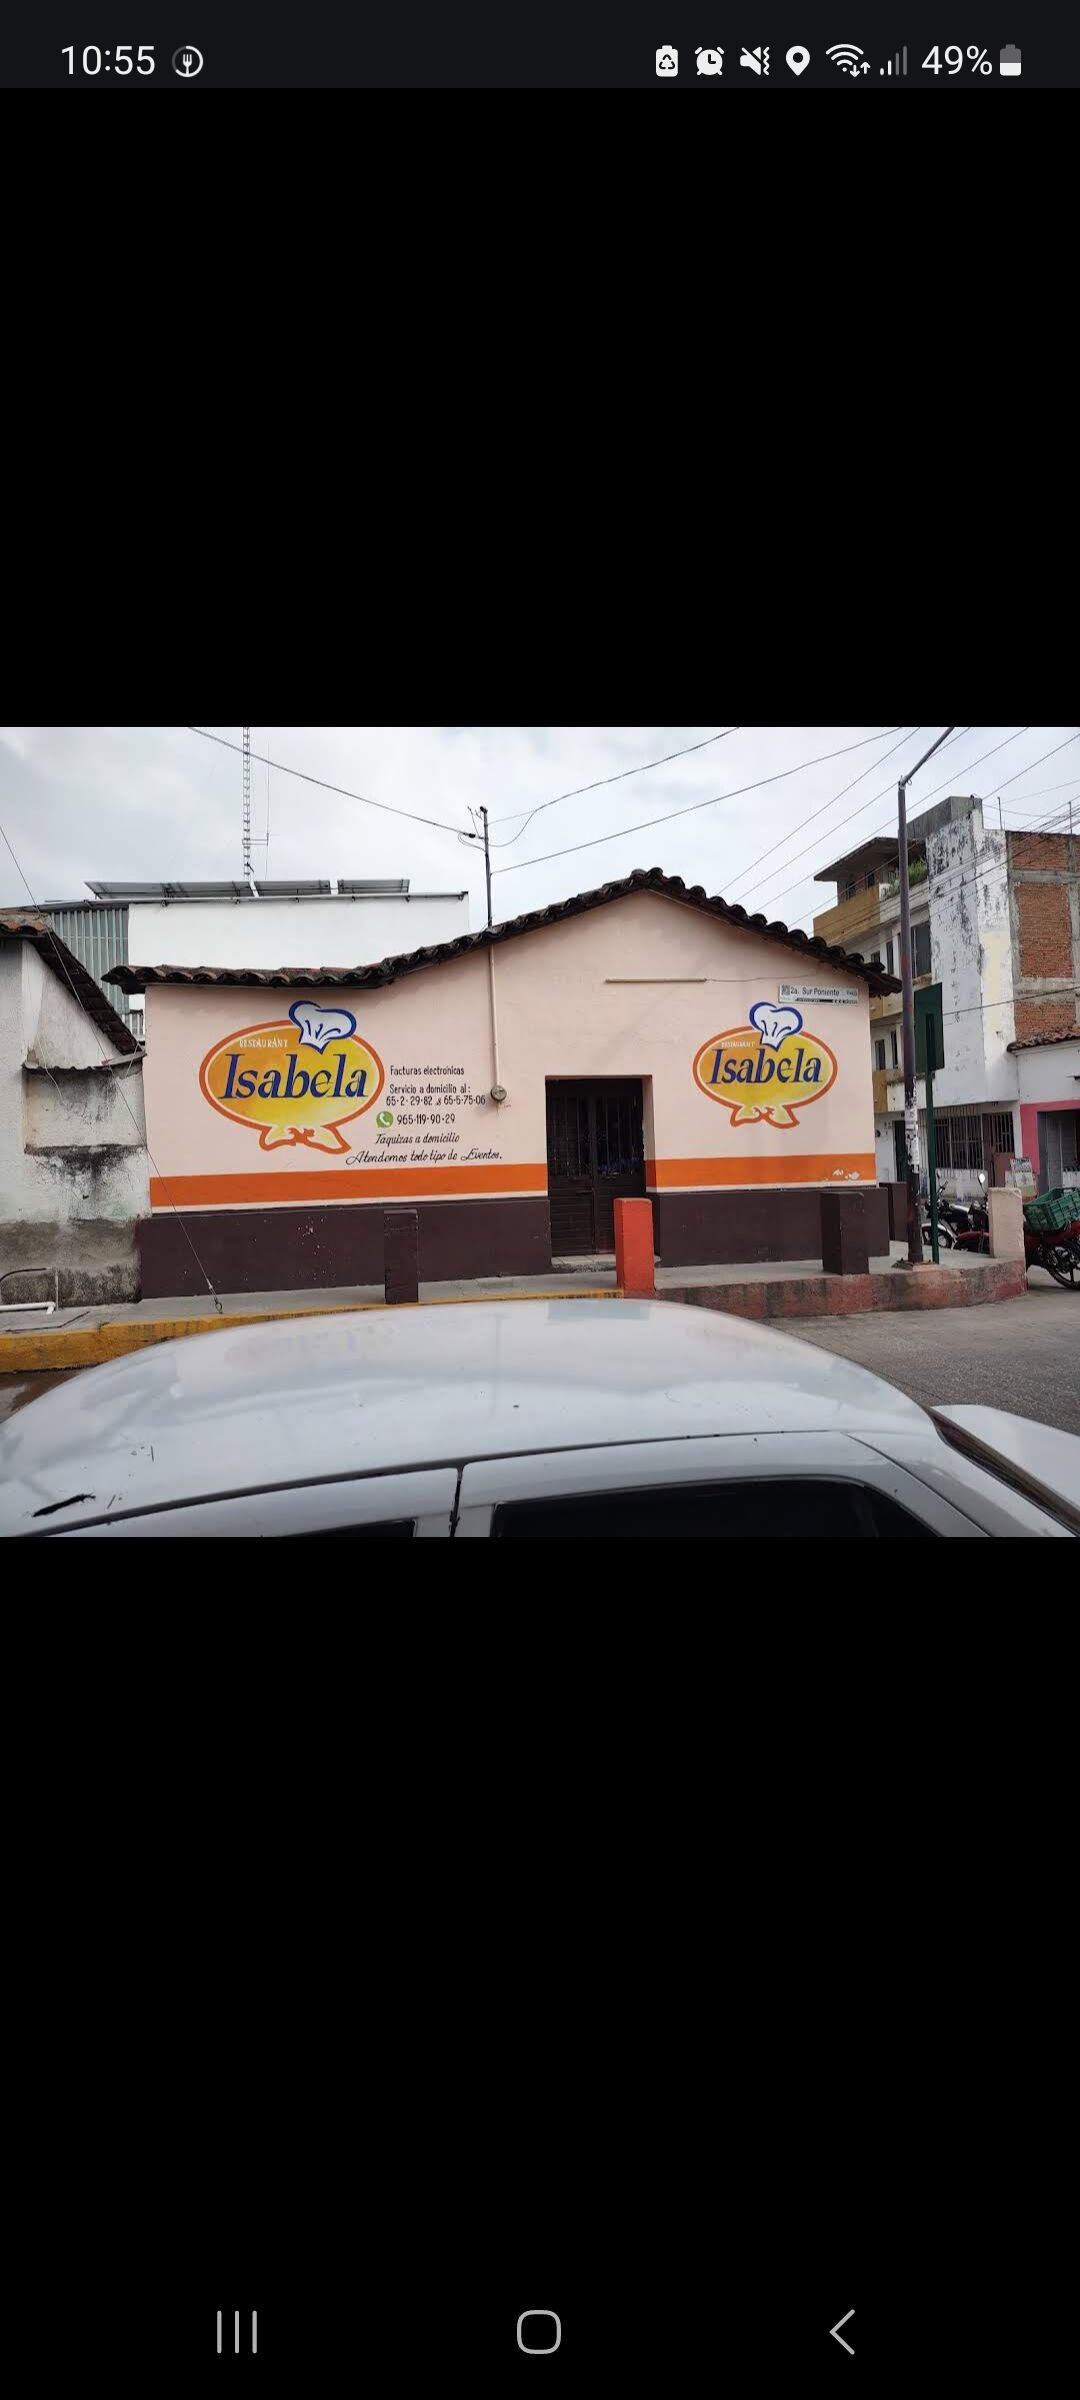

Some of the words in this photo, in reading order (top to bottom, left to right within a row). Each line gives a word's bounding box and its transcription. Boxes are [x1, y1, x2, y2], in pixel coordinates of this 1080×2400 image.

[390, 1065, 422, 1076] Facturas
[706, 1048, 823, 1085] Isabela
[217, 1053, 369, 1099] Isabela
[389, 1083, 417, 1095] Servicio
[419, 1086, 425, 1094] a
[426, 1083, 457, 1094] domicilio
[375, 1133, 414, 1147] Taquizas
[415, 1135, 420, 1144] a
[422, 1132, 460, 1144] domicilio
[345, 1150, 407, 1165] Atendemos
[410, 1149, 430, 1161] todo
[430, 1151, 447, 1164] tipo
[447, 1149, 458, 1161] de
